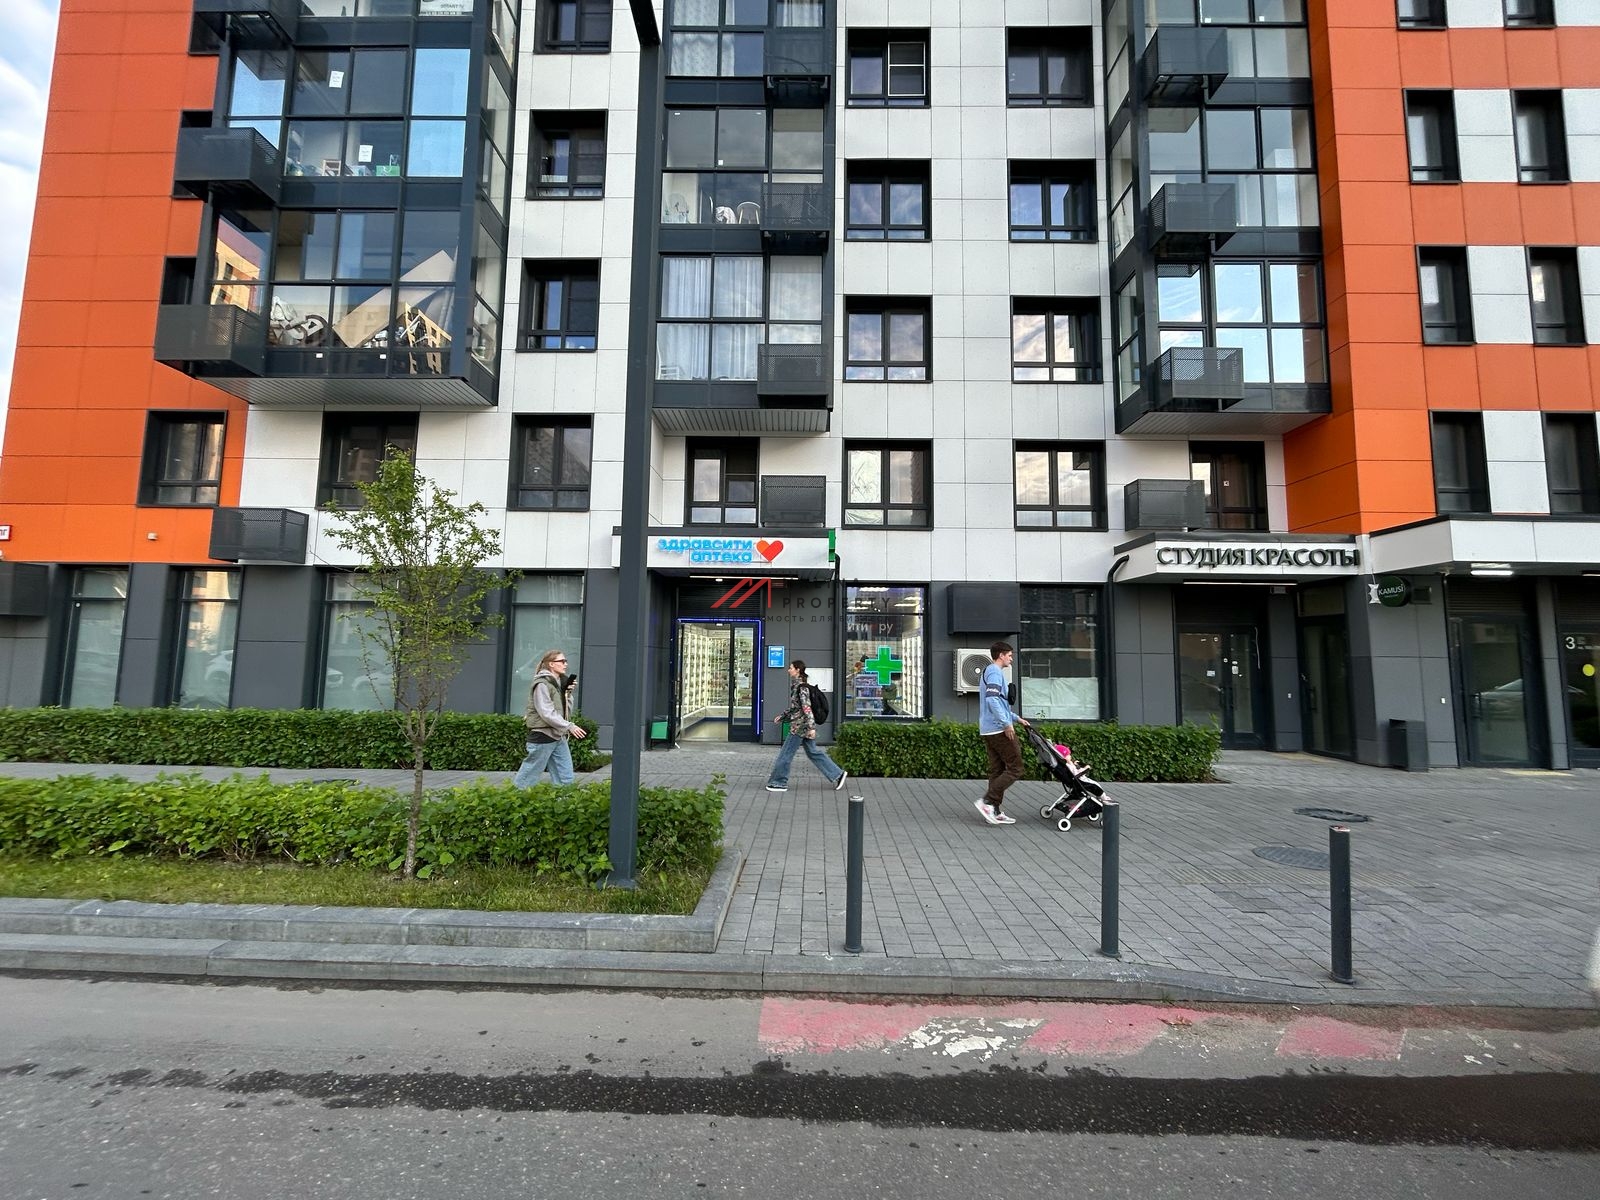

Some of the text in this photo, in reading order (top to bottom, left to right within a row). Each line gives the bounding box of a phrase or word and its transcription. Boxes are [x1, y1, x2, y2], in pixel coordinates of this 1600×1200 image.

[657, 538, 753, 554] здравсити
[690, 550, 753, 563] аптека
[1157, 547, 1360, 569] СТУДИЯ КРАСОТЫ
